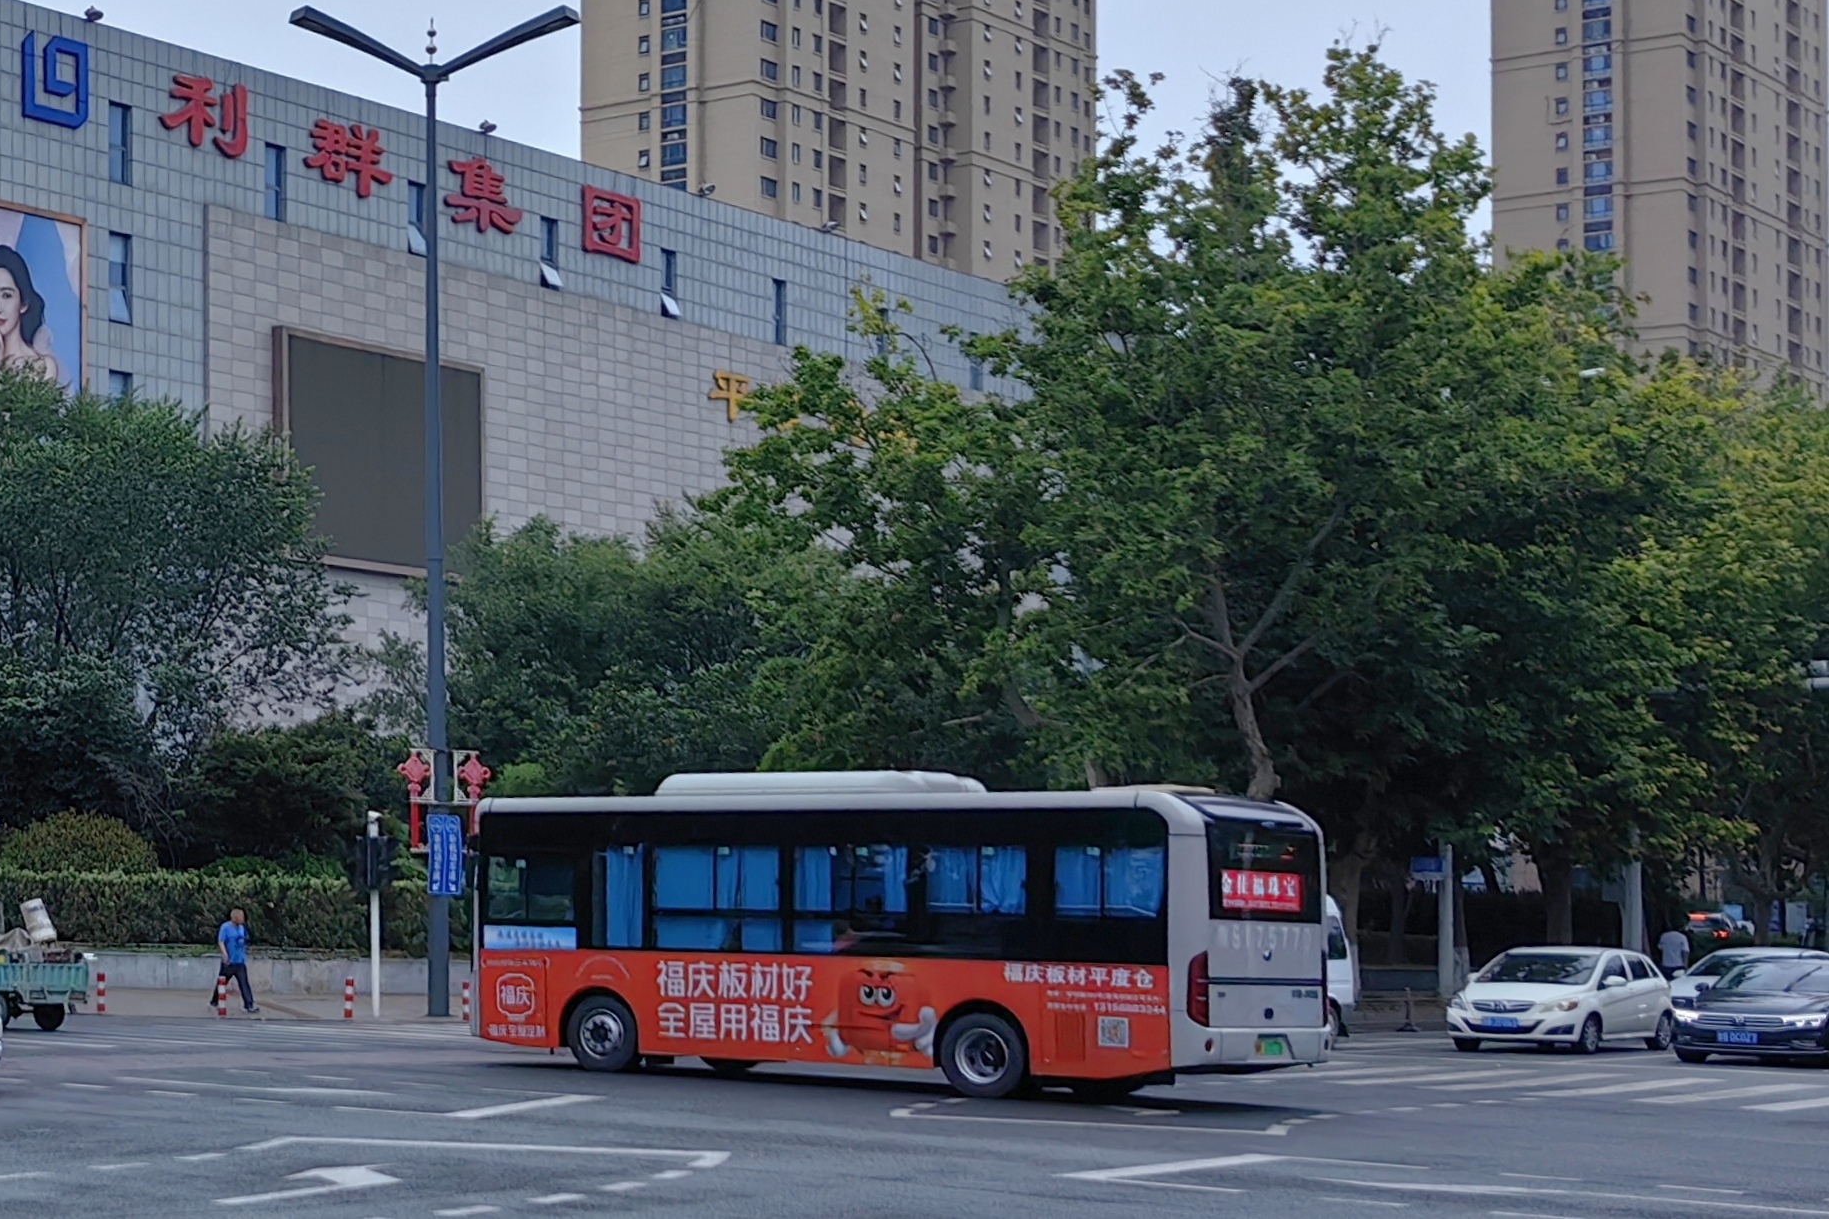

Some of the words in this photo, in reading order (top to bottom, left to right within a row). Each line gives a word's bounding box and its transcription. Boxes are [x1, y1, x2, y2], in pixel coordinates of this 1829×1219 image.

[159, 74, 642, 264] 利群集团
[500, 984, 532, 1006] 福庆
[656, 960, 813, 1002] 福庆板材好
[1004, 962, 1154, 989] 福庆板材平度仓
[657, 1001, 813, 1044] 全屋用福庆
